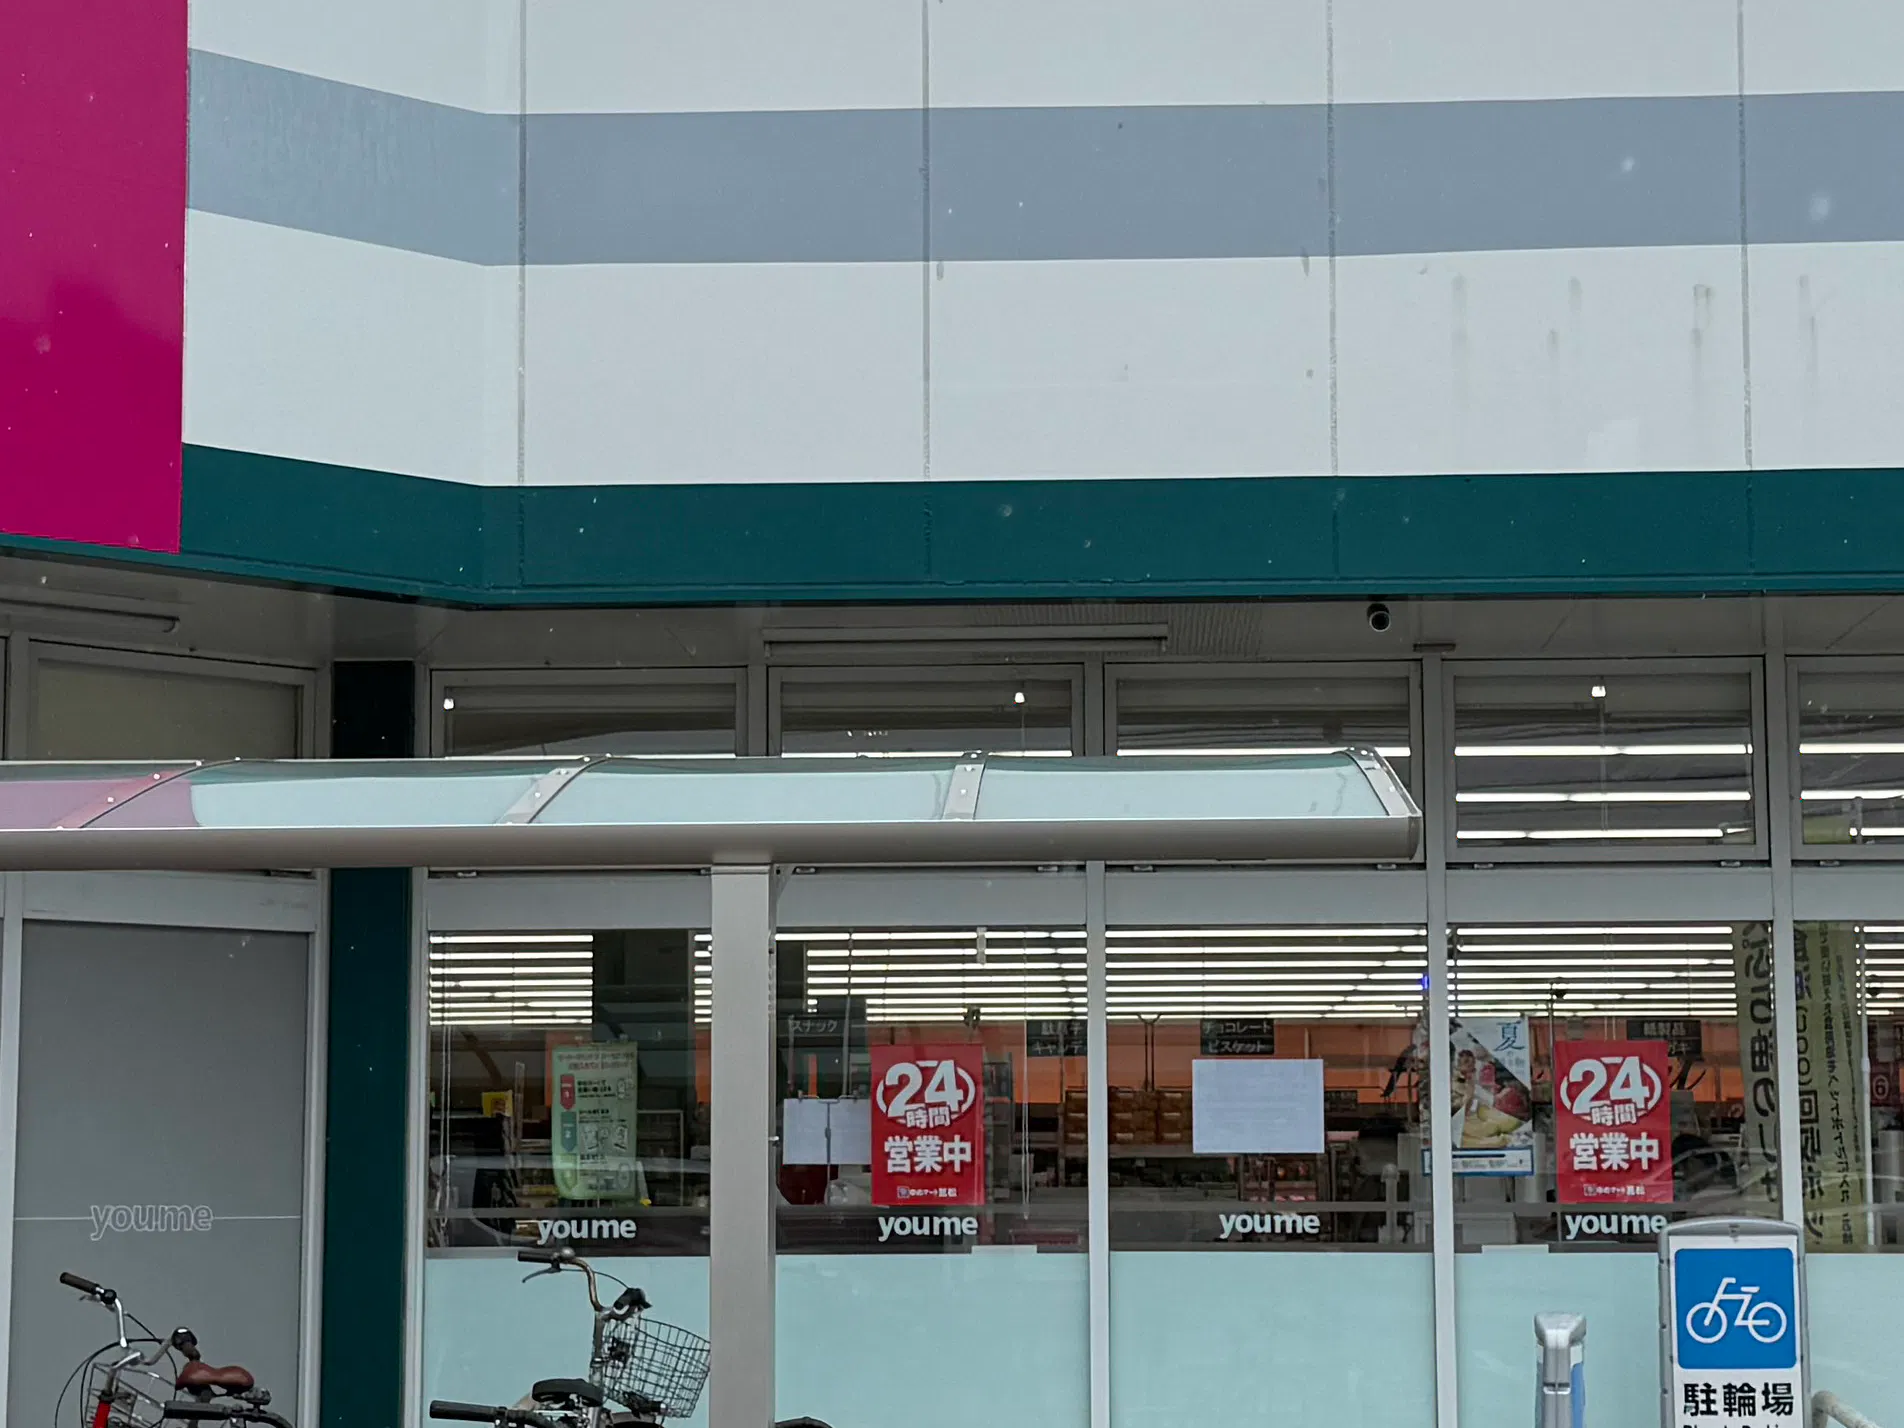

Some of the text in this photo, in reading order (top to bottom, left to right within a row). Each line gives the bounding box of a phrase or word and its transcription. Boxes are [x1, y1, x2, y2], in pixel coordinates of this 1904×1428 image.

[1203, 1021, 1272, 1034] チョコレート
[1494, 1019, 1526, 1052] 夏
[1208, 1039, 1266, 1054] ビスケット
[885, 1059, 964, 1118] 24
[1568, 1056, 1649, 1115] 24
[906, 1107, 951, 1128] 時間
[1590, 1103, 1638, 1126] 時間
[884, 1134, 972, 1172] 営業中
[1569, 1132, 1660, 1172] 営業中
[90, 1201, 213, 1242] youme
[537, 1219, 636, 1245] youme
[878, 1215, 978, 1242] youme
[1219, 1211, 1321, 1238] youme
[1564, 1212, 1668, 1240] youme
[1683, 1382, 1795, 1418] 駐輪場
